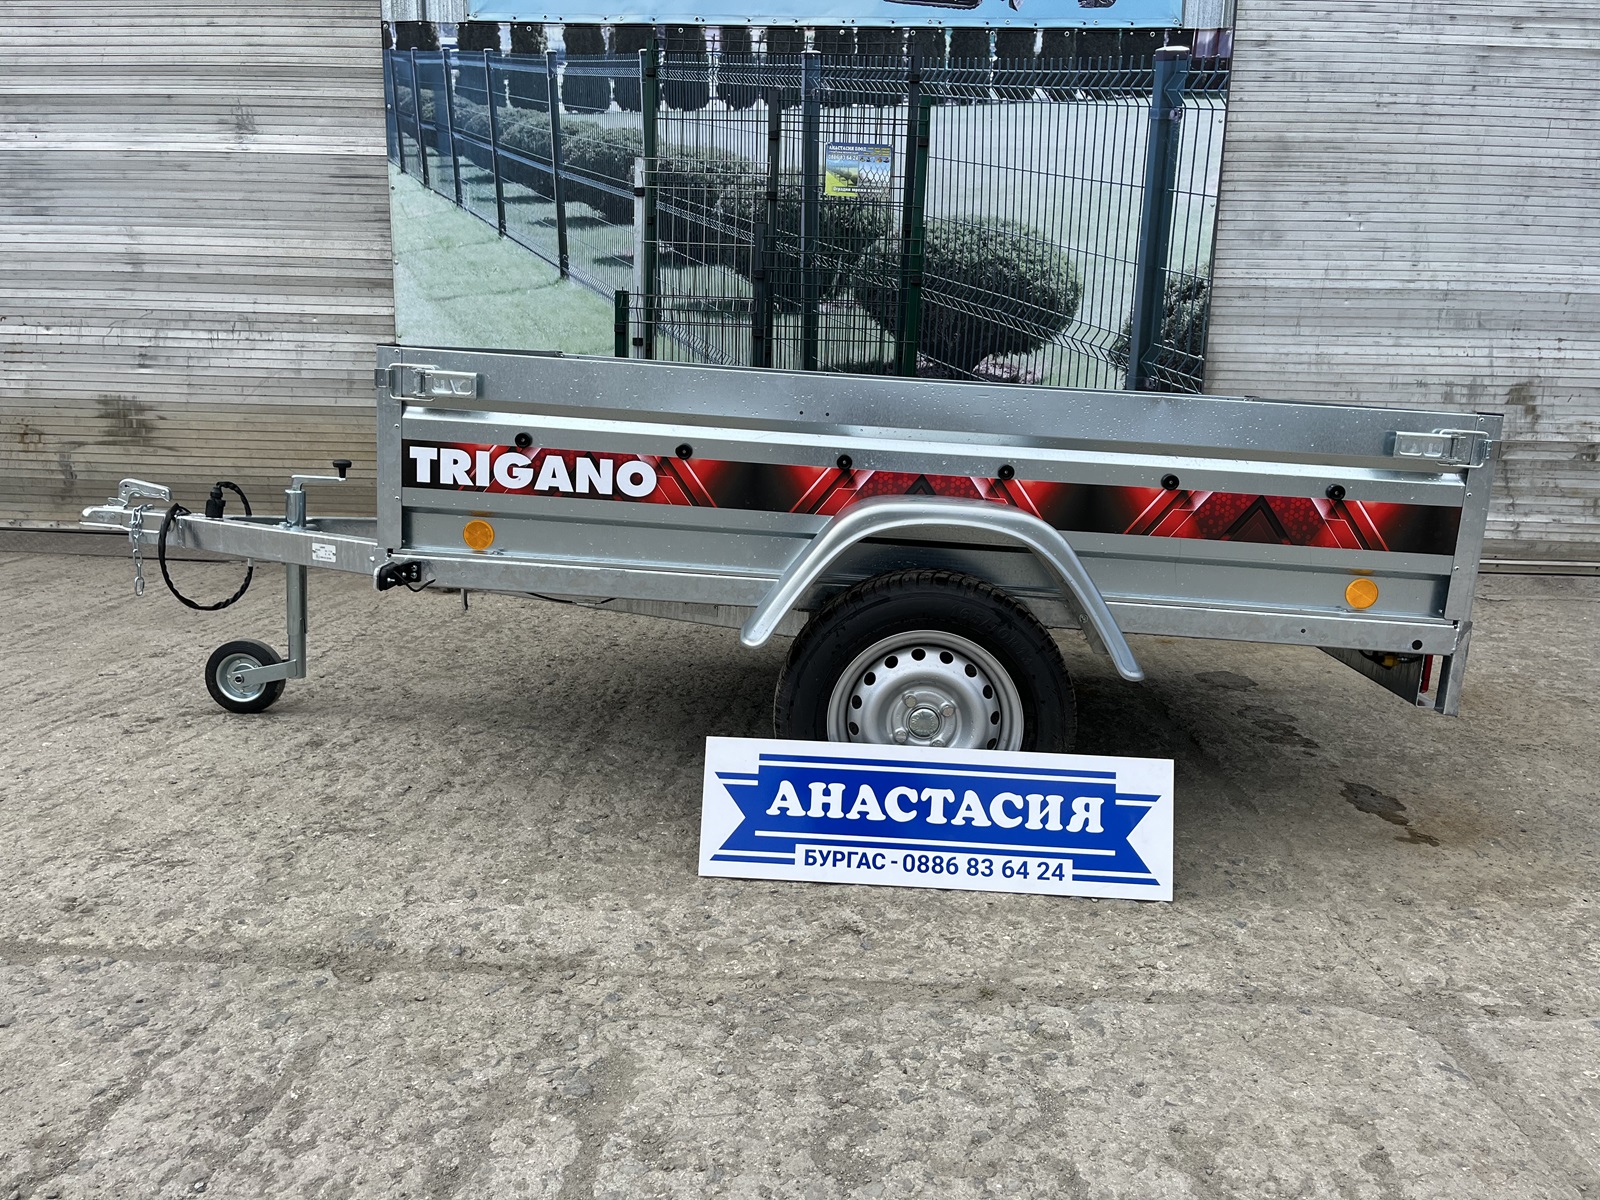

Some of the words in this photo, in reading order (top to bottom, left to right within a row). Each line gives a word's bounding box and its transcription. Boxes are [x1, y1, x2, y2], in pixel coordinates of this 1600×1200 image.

[409, 446, 658, 498] TRIGANO
[766, 780, 1105, 833] АНАСТАСИЯ
[804, 849, 886, 870] БУРГАС
[902, 854, 959, 875] 0886
[966, 857, 994, 878] 83
[1001, 860, 1030, 880] 64
[1036, 861, 1066, 882] 24
